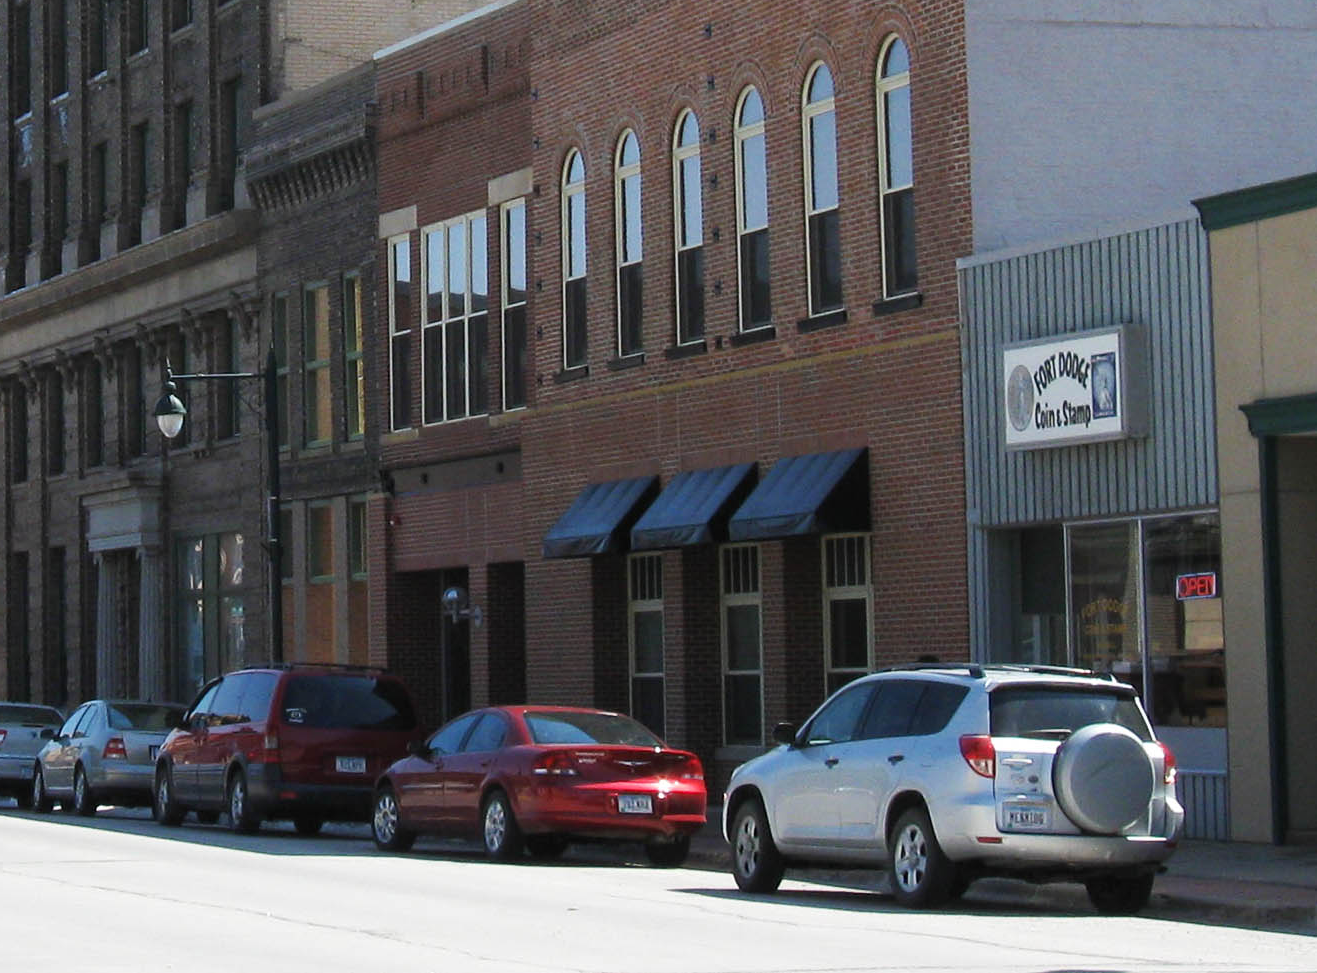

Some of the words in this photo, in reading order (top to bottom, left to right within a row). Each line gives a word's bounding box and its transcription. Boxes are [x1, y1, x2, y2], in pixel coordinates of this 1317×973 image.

[1033, 354, 1057, 396] FORT
[1058, 351, 1090, 389] DODGE
[1035, 402, 1055, 429] Coin
[1063, 400, 1091, 428] Stamp
[1178, 576, 1214, 597] OPEN
